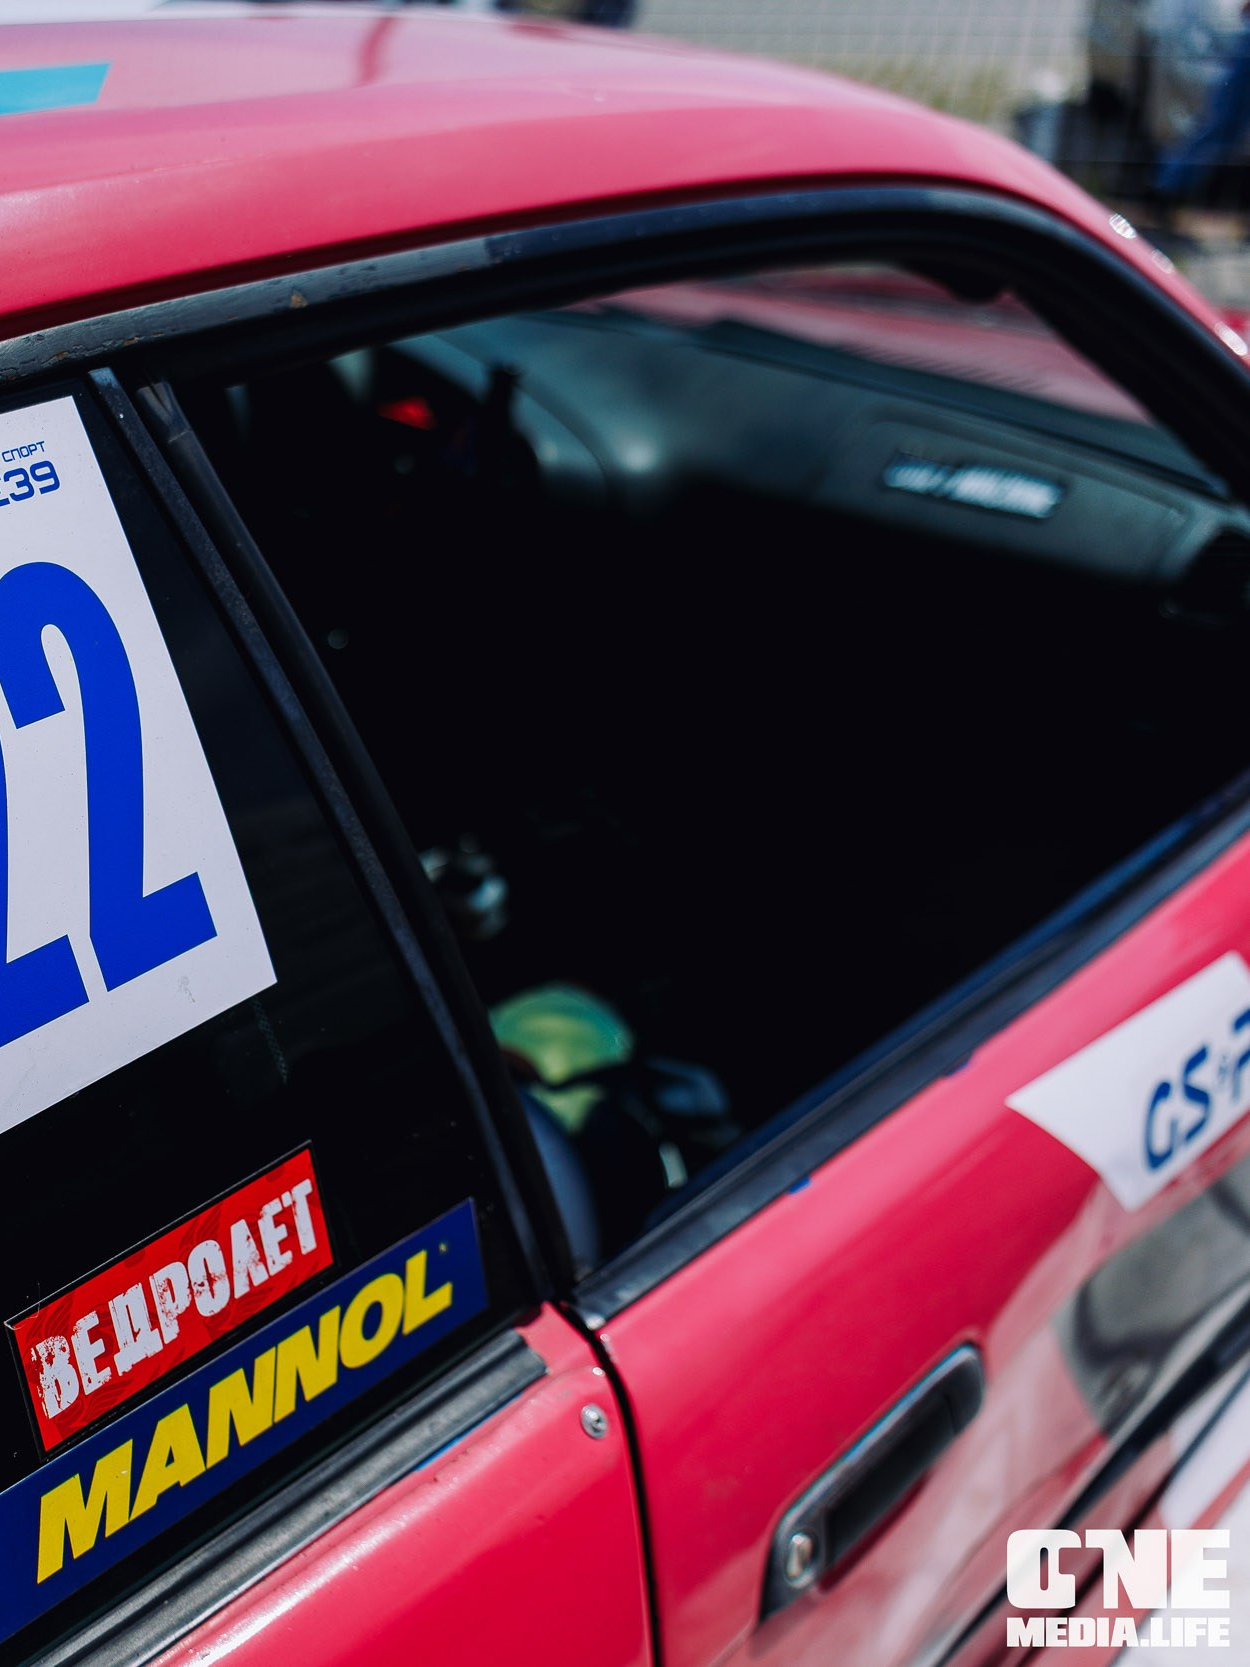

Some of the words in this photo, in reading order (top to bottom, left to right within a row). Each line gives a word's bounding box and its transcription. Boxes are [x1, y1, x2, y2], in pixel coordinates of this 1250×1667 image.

[1, 440, 46, 463] СПОРТ
[30, 1178, 318, 1420] ВЕДРОЛЕТ
[36, 1249, 453, 1585] MANNOL
